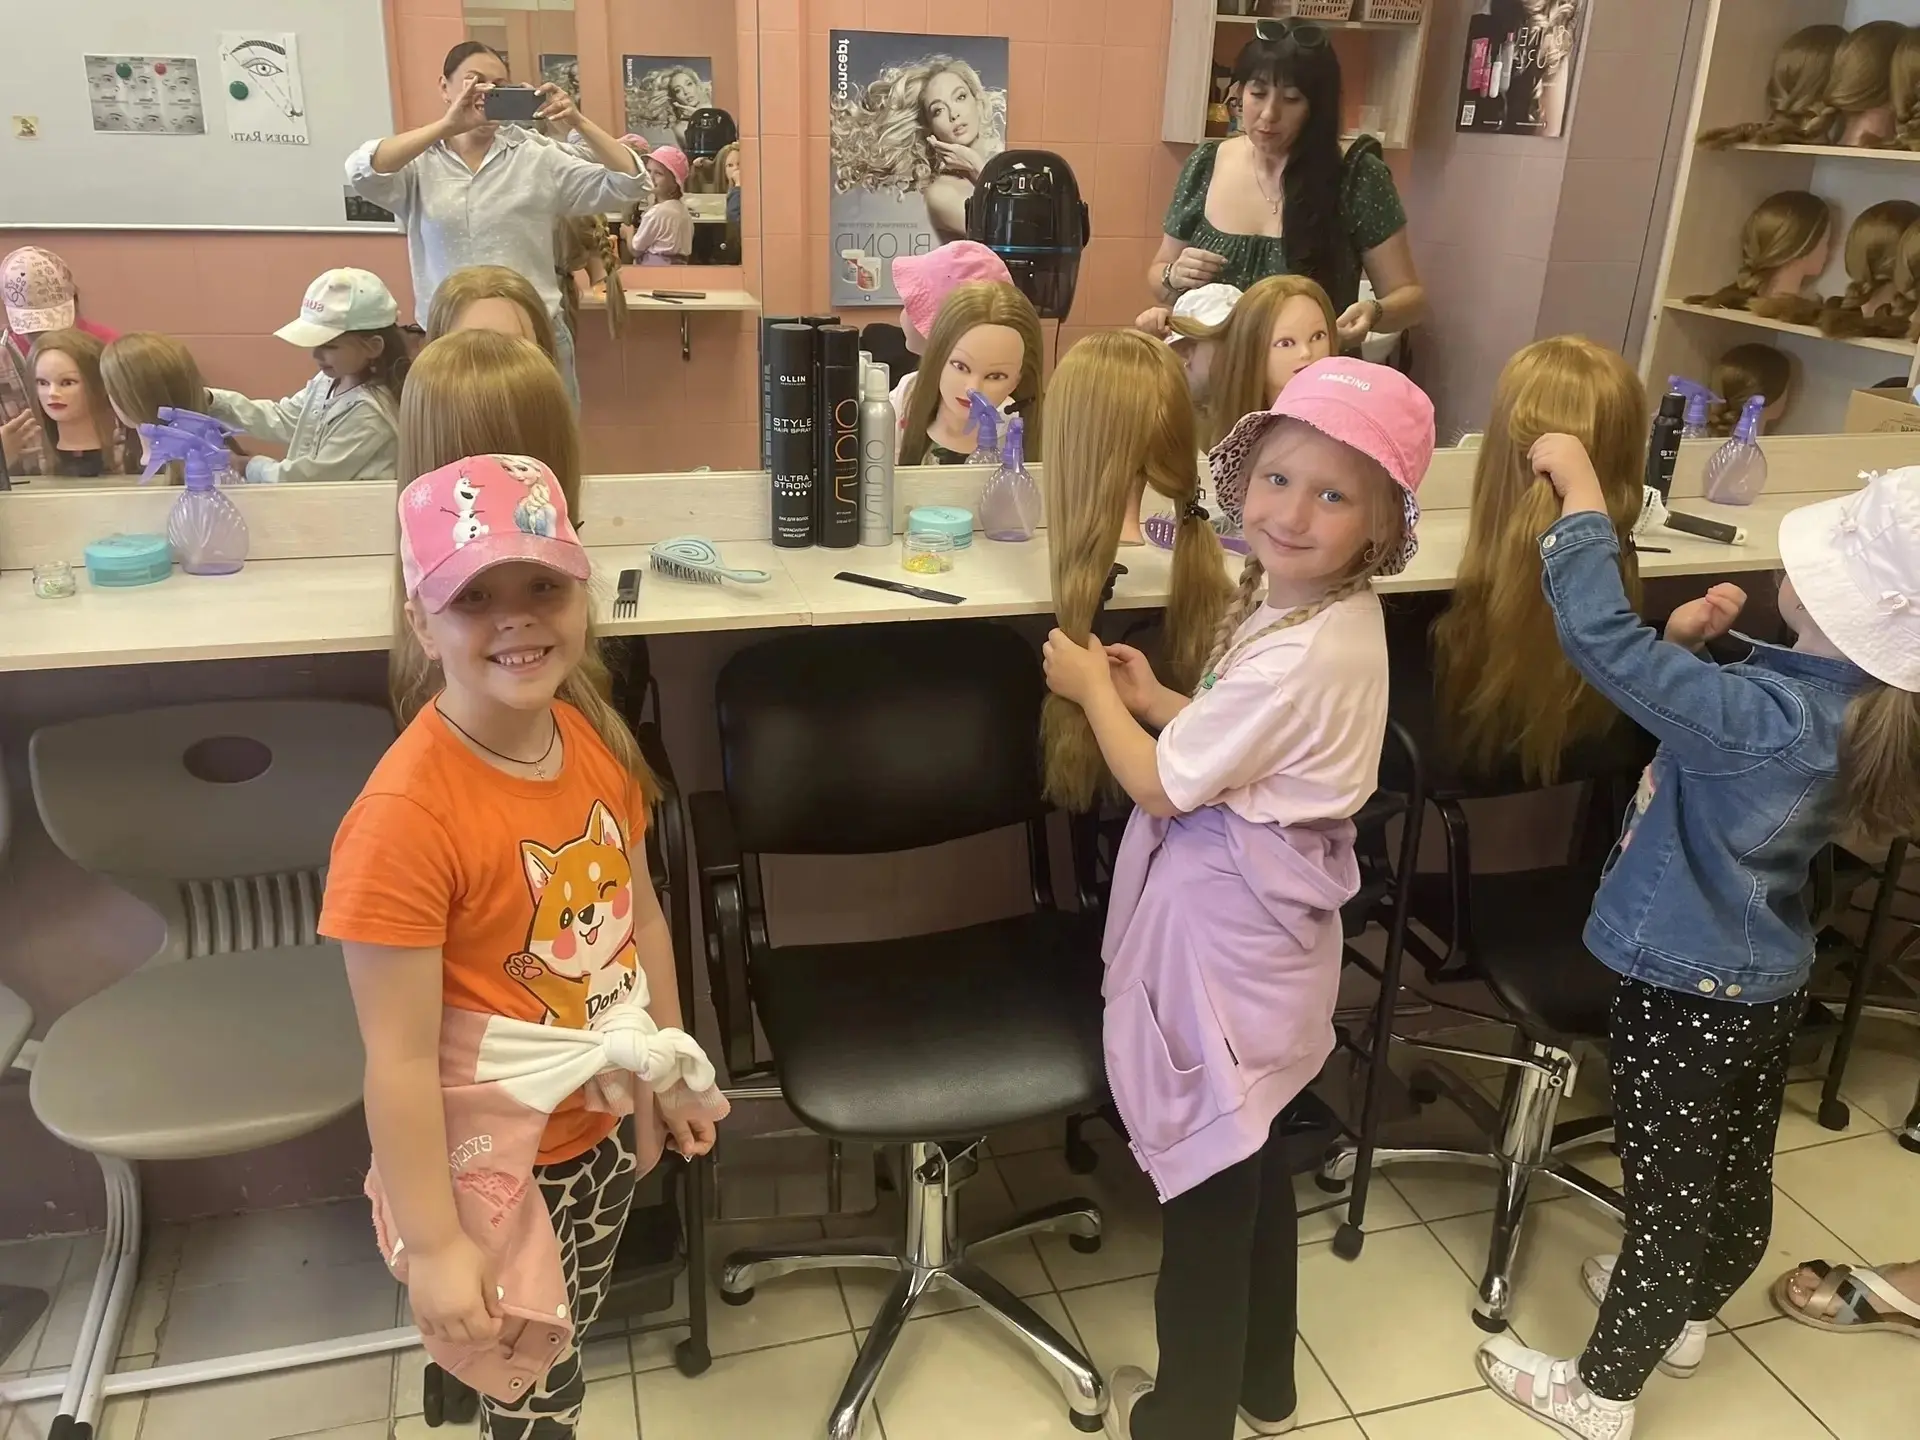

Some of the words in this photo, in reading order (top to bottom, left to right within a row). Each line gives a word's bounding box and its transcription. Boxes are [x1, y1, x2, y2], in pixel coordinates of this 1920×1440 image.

[780, 375, 806, 383] OLLIN
[1318, 373, 1371, 391] AMAZING
[773, 417, 812, 427] STYLE
[774, 481, 812, 489] STRONG
[585, 969, 637, 1020] Don't
